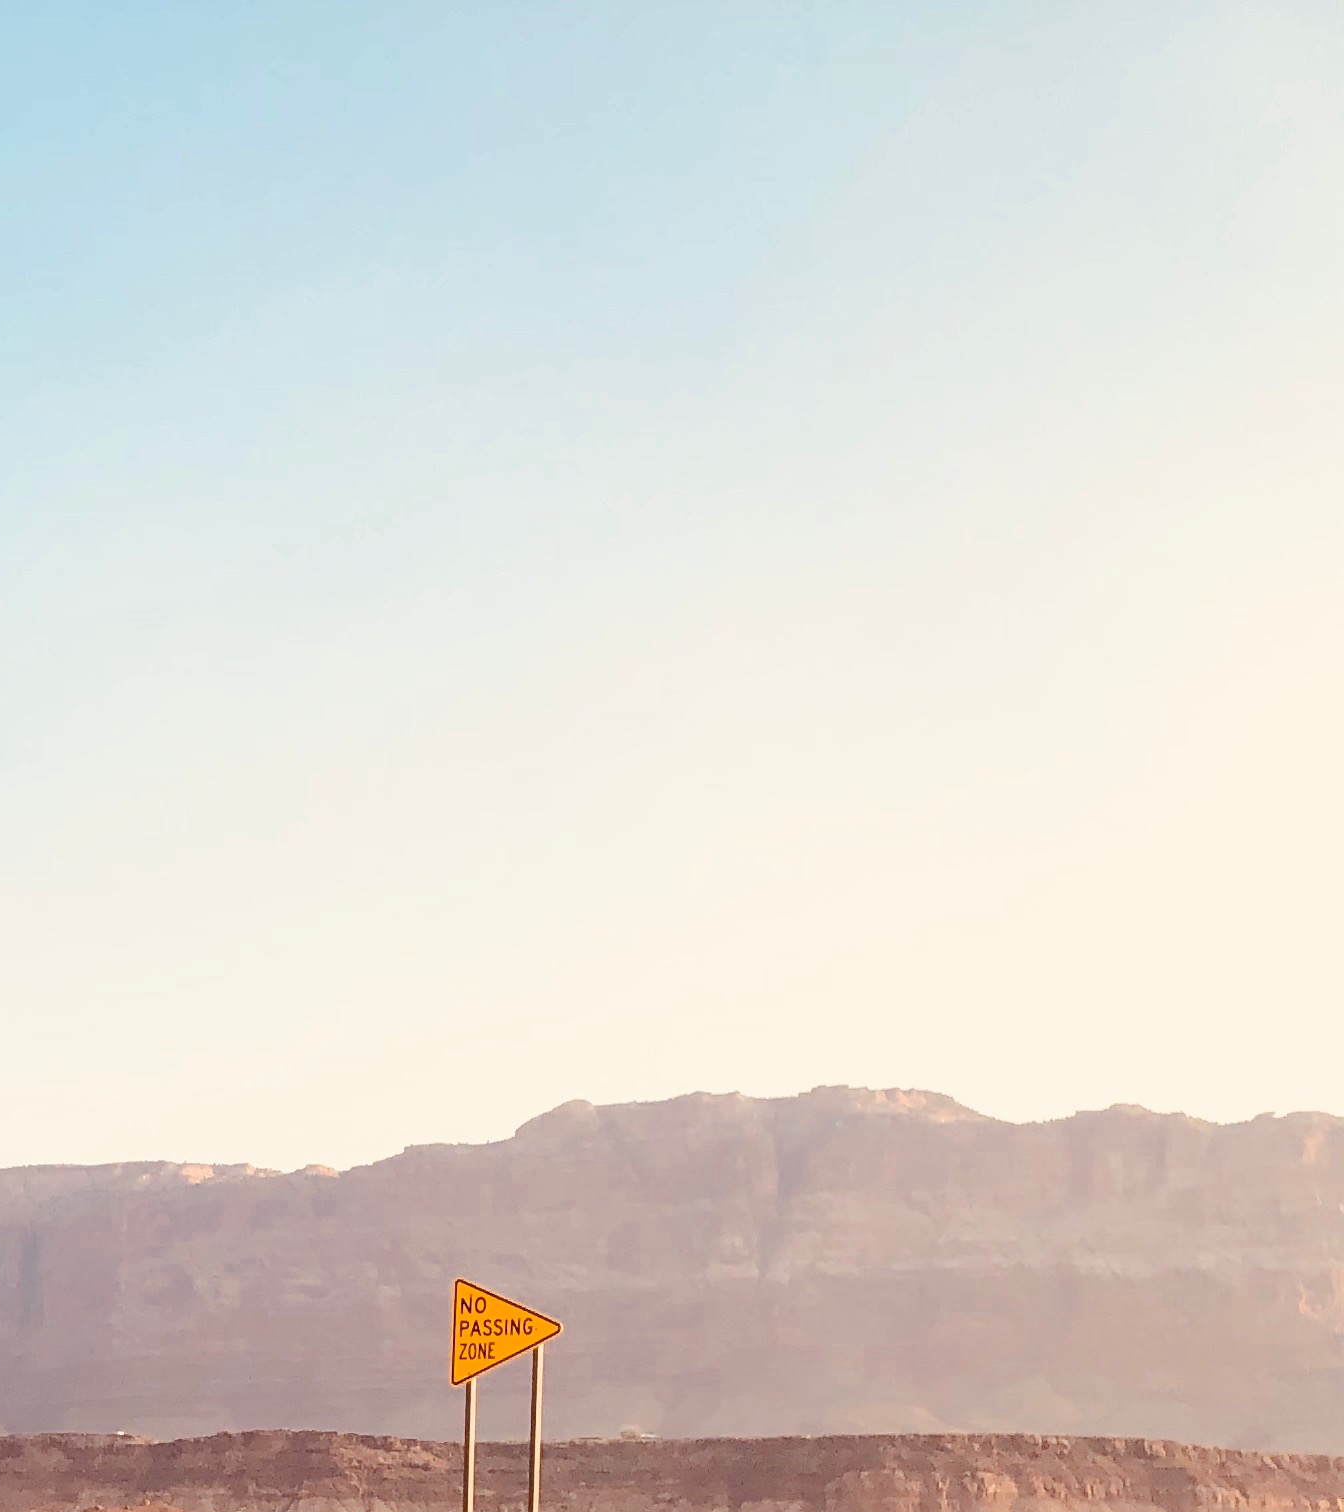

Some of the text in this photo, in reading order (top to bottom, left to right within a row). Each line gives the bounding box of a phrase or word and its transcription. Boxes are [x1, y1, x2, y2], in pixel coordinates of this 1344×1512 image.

[461, 1295, 486, 1314] NO
[460, 1318, 533, 1337] PASSING
[459, 1342, 495, 1360] ZONE
